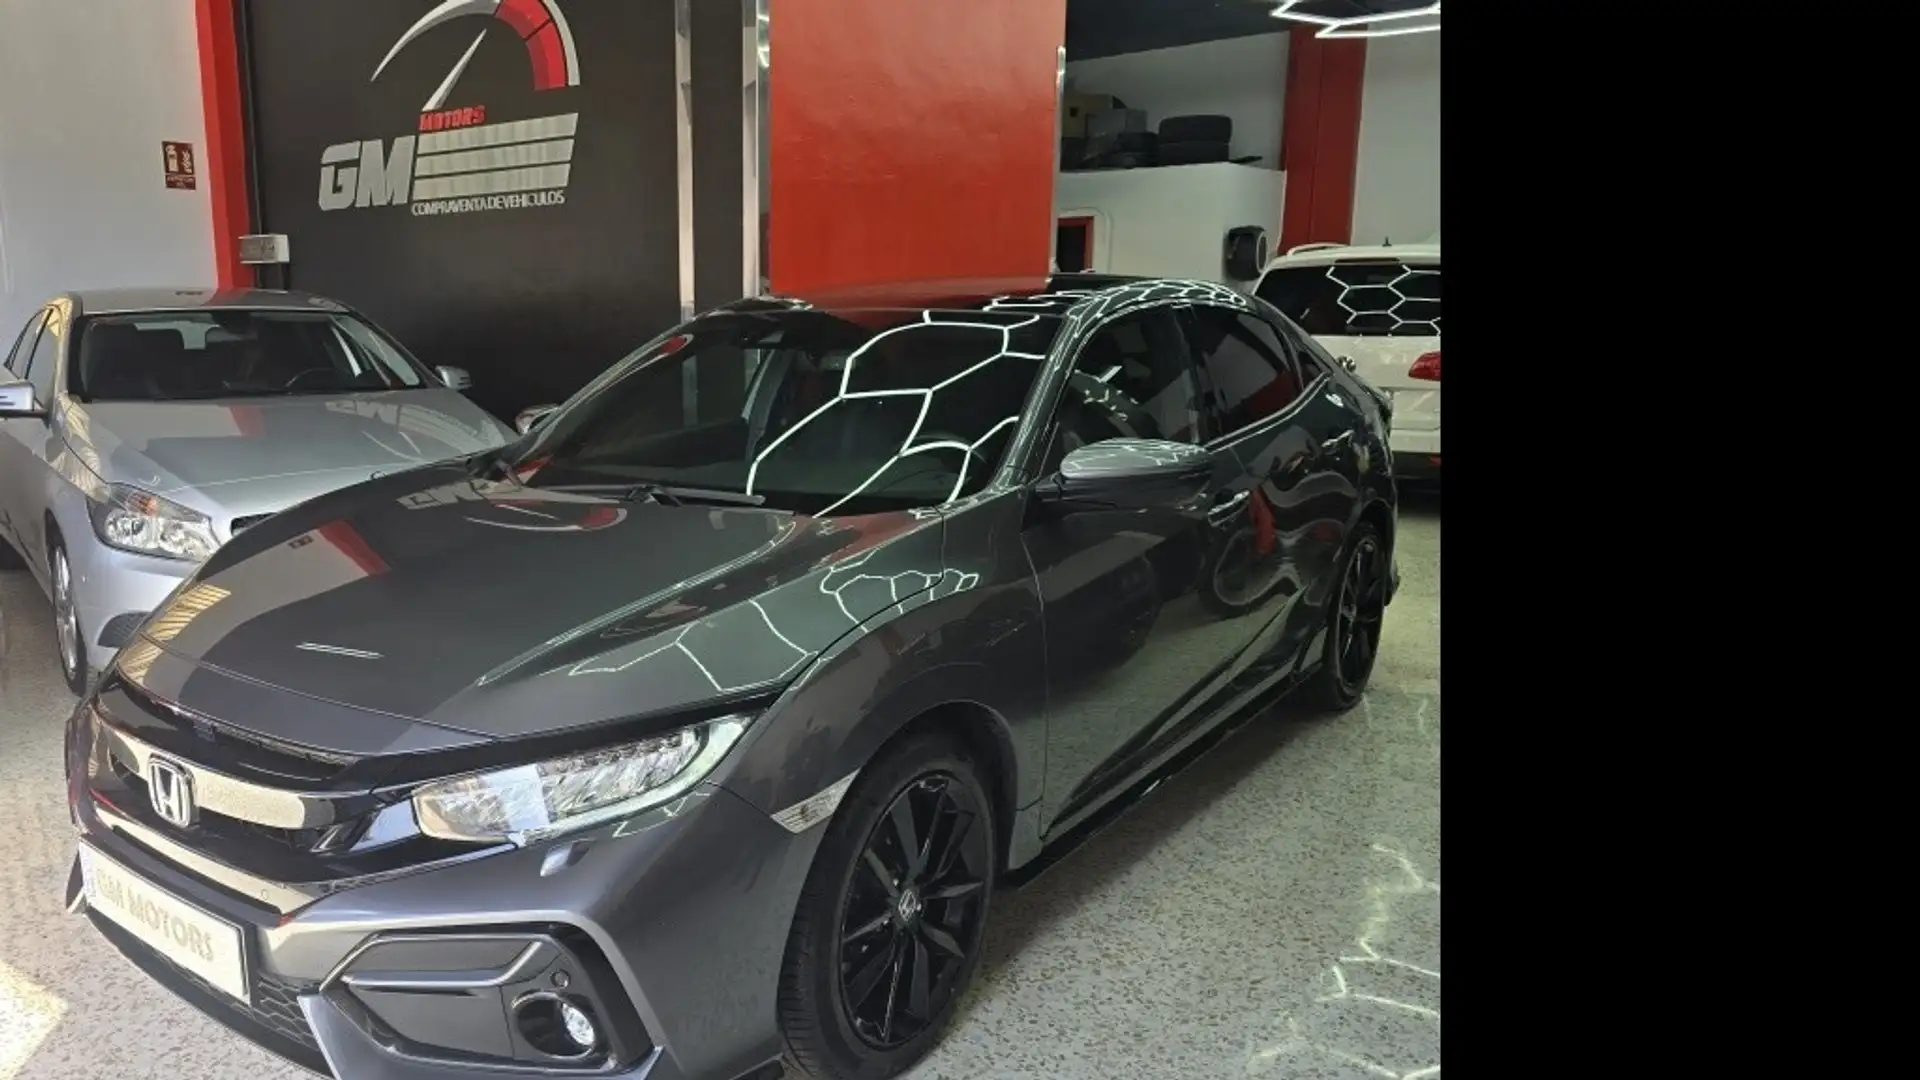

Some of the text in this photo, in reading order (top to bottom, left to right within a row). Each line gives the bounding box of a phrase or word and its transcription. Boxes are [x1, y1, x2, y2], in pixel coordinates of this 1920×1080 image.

[418, 105, 486, 132] MOTORS
[319, 135, 416, 211] GM
[126, 886, 214, 962] MOTORS
